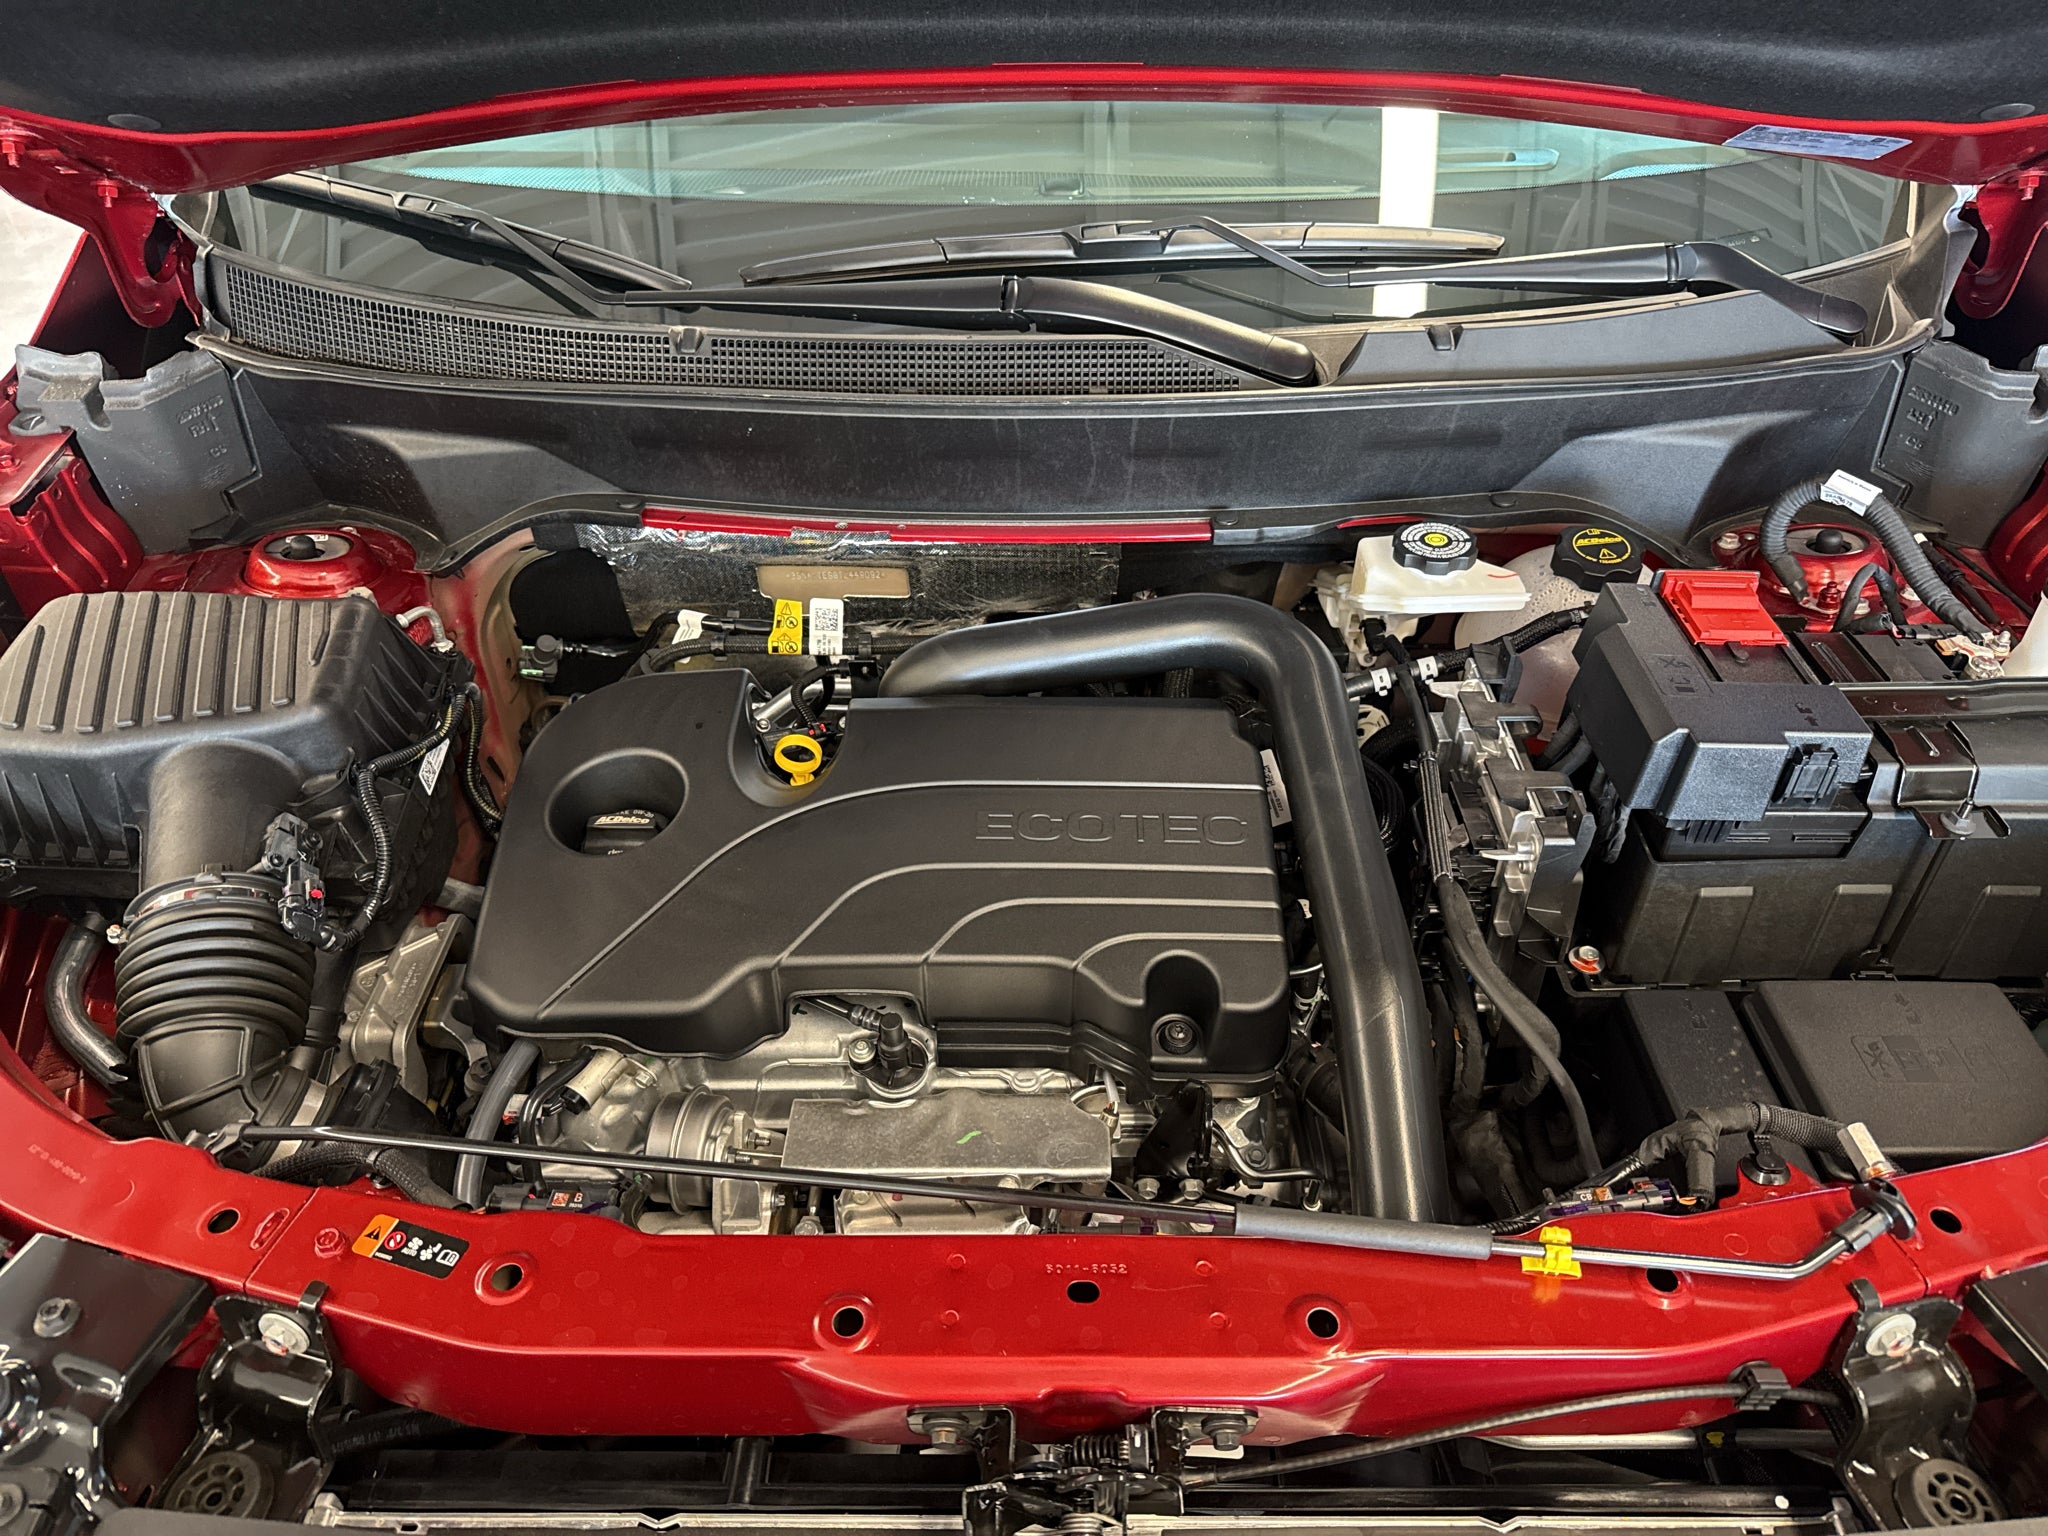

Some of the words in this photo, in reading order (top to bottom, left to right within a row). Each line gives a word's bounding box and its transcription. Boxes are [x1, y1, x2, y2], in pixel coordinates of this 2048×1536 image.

[1575, 536, 1622, 547] ACDelco
[594, 815, 650, 825] ACDelco
[975, 812, 1248, 845] ECOTEC
[573, 1192, 584, 1203] B
[1580, 1193, 1593, 1202] CB
[400, 1246, 418, 1257] AUTO
